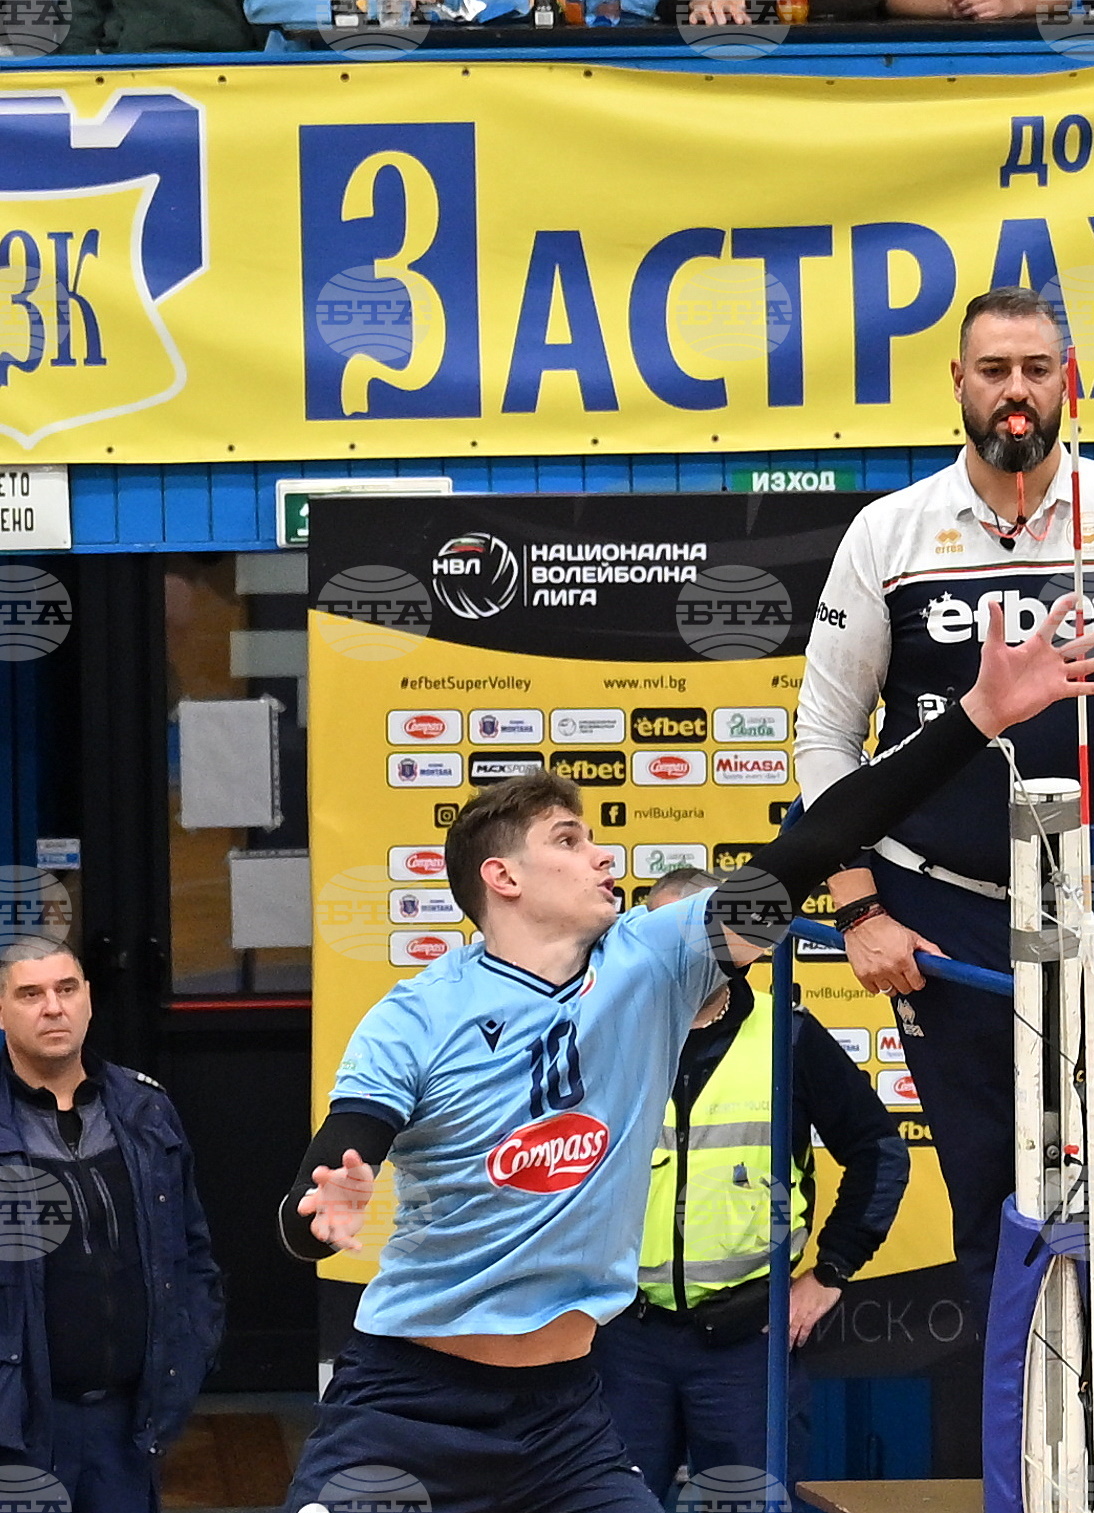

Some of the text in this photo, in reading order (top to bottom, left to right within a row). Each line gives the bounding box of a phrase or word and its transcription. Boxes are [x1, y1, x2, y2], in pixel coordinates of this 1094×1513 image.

[0, 228, 107, 389] ЗК
[0, 473, 31, 498] ЕТО
[752, 470, 835, 492] ИЗХОД
[0, 508, 35, 532] ЕНО
[531, 543, 707, 562] НАЦИОНАЛНА
[433, 557, 480, 576] НВЛ
[531, 561, 698, 583] ВОЛЕЙБОЛНА
[532, 588, 597, 606] ЛИГА
[400, 676, 532, 692] #efbetSuperVolley
[603, 676, 687, 692] www.nvl.bg
[634, 806, 704, 821] nvlBulgaria
[524, 1020, 585, 1119] 10
[491, 1134, 607, 1184] Compass
